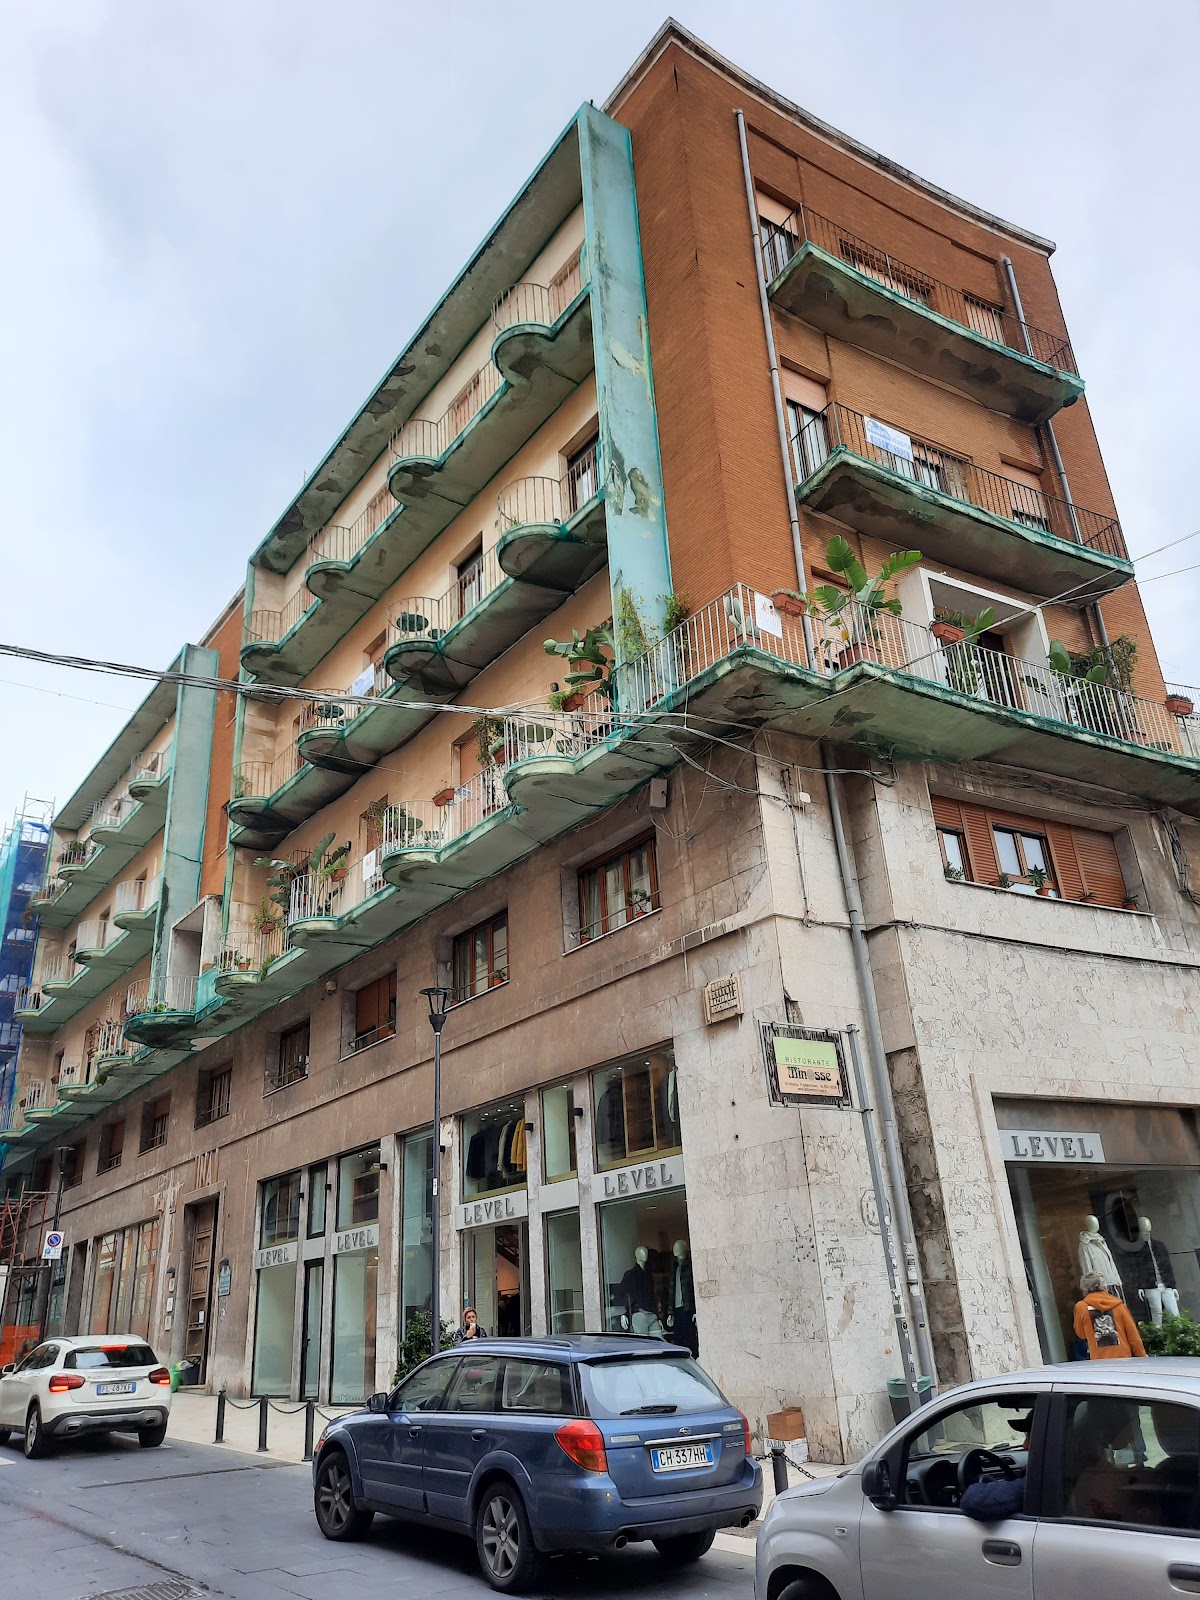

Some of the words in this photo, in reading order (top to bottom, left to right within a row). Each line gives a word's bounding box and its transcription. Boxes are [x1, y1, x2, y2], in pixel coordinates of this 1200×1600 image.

[785, 1056, 830, 1067] RISTORANTE
[787, 1067, 832, 1082] Minosse
[1010, 1136, 1094, 1159] LEVEL
[603, 1164, 673, 1196] LEVEL
[463, 1197, 515, 1225] LEVEL
[337, 1229, 373, 1251] LEVEL
[259, 1248, 290, 1267] LEVEL
[660, 1451, 674, 1467] CH
[675, 1447, 706, 1465] 337HH
